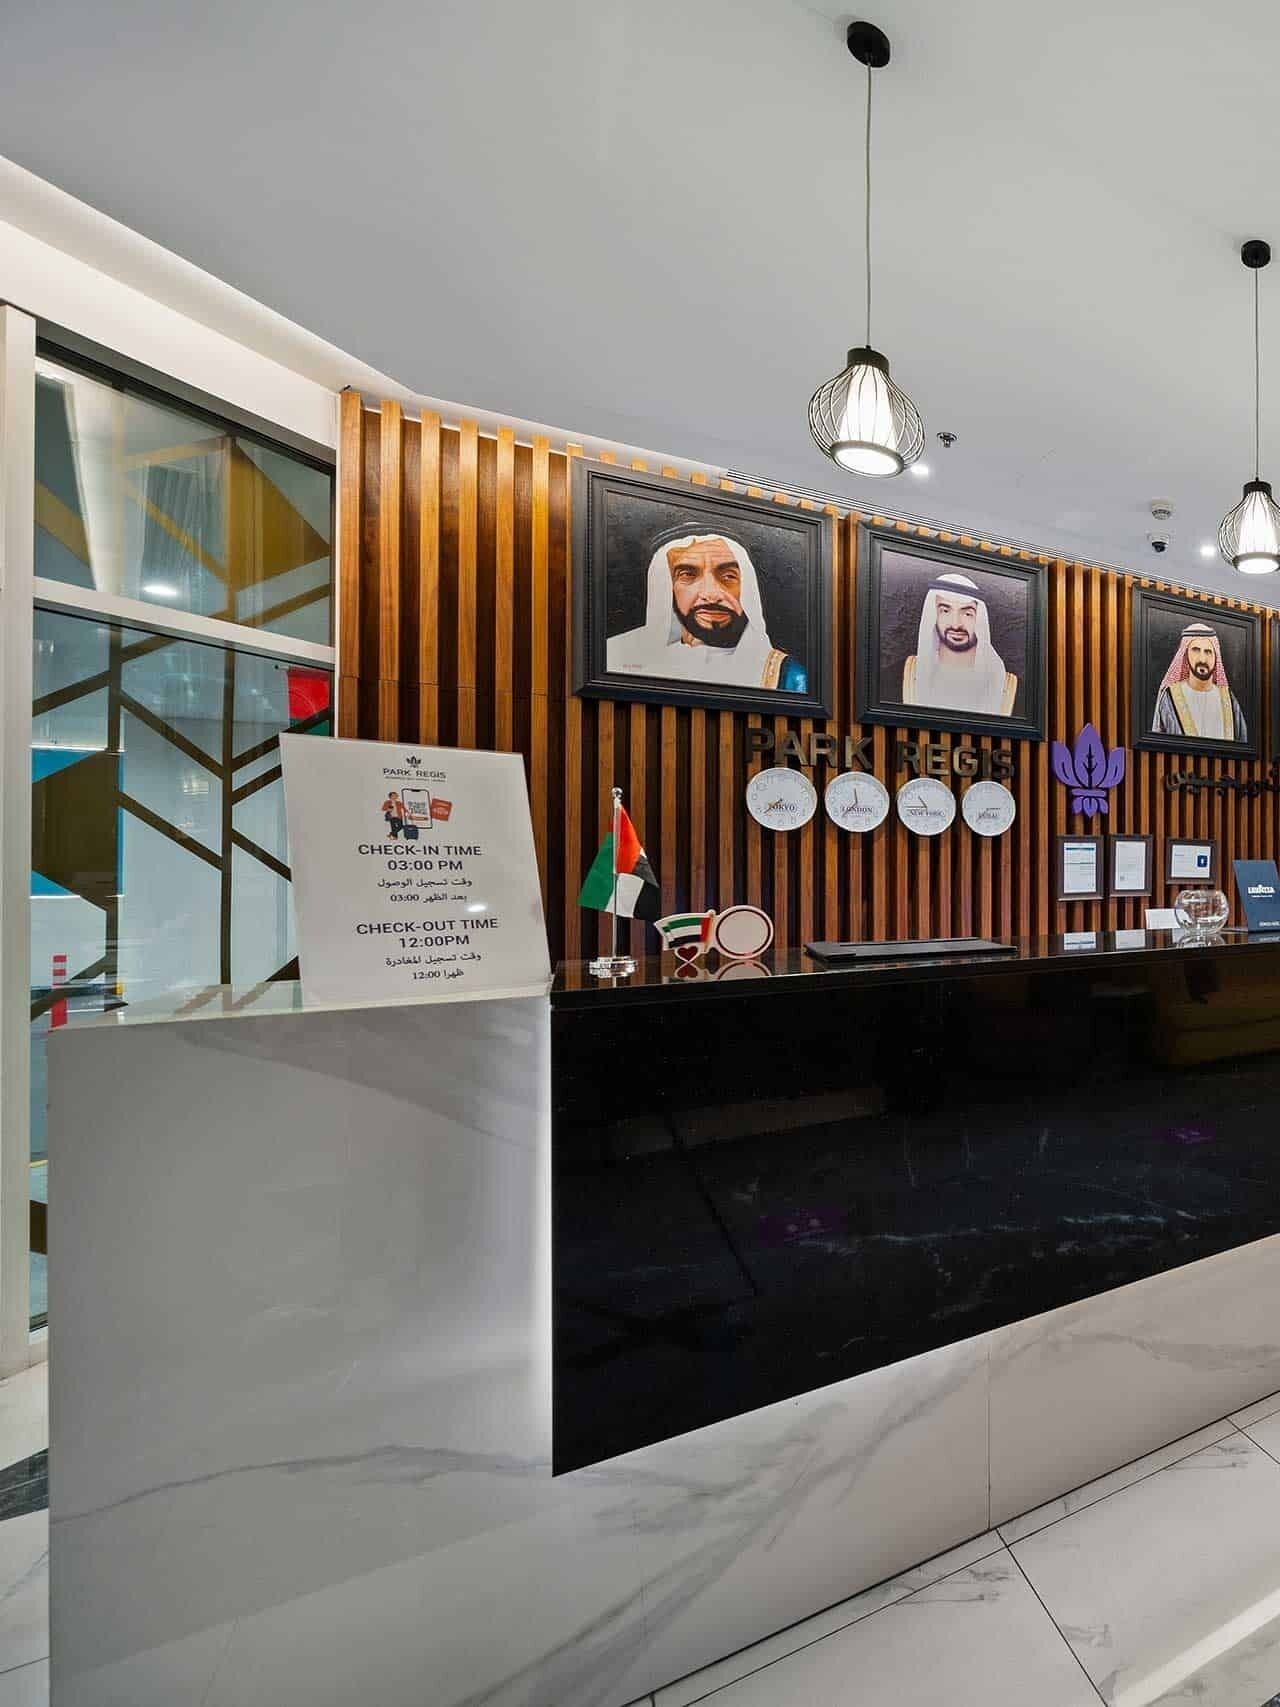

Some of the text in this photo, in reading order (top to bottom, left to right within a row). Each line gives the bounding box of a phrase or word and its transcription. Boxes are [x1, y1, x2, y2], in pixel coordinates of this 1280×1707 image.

[744, 727, 1016, 779] PARK REGIS
[383, 767, 411, 777] PARK
[415, 770, 447, 779] REGIS
[357, 844, 483, 856] CHECK-IN TIME
[387, 860, 463, 871] 03:00 PM
[377, 878, 473, 888] وقت تسجيل الوصول
[390, 893, 468, 904] بعد الظهر 03:00
[356, 918, 499, 935] CHECK-OUT TIME
[399, 935, 470, 949] 12:00PM
[425, 954, 457, 966] تسجيل
[460, 952, 482, 963] وقت
[412, 970, 441, 980] 12:00
